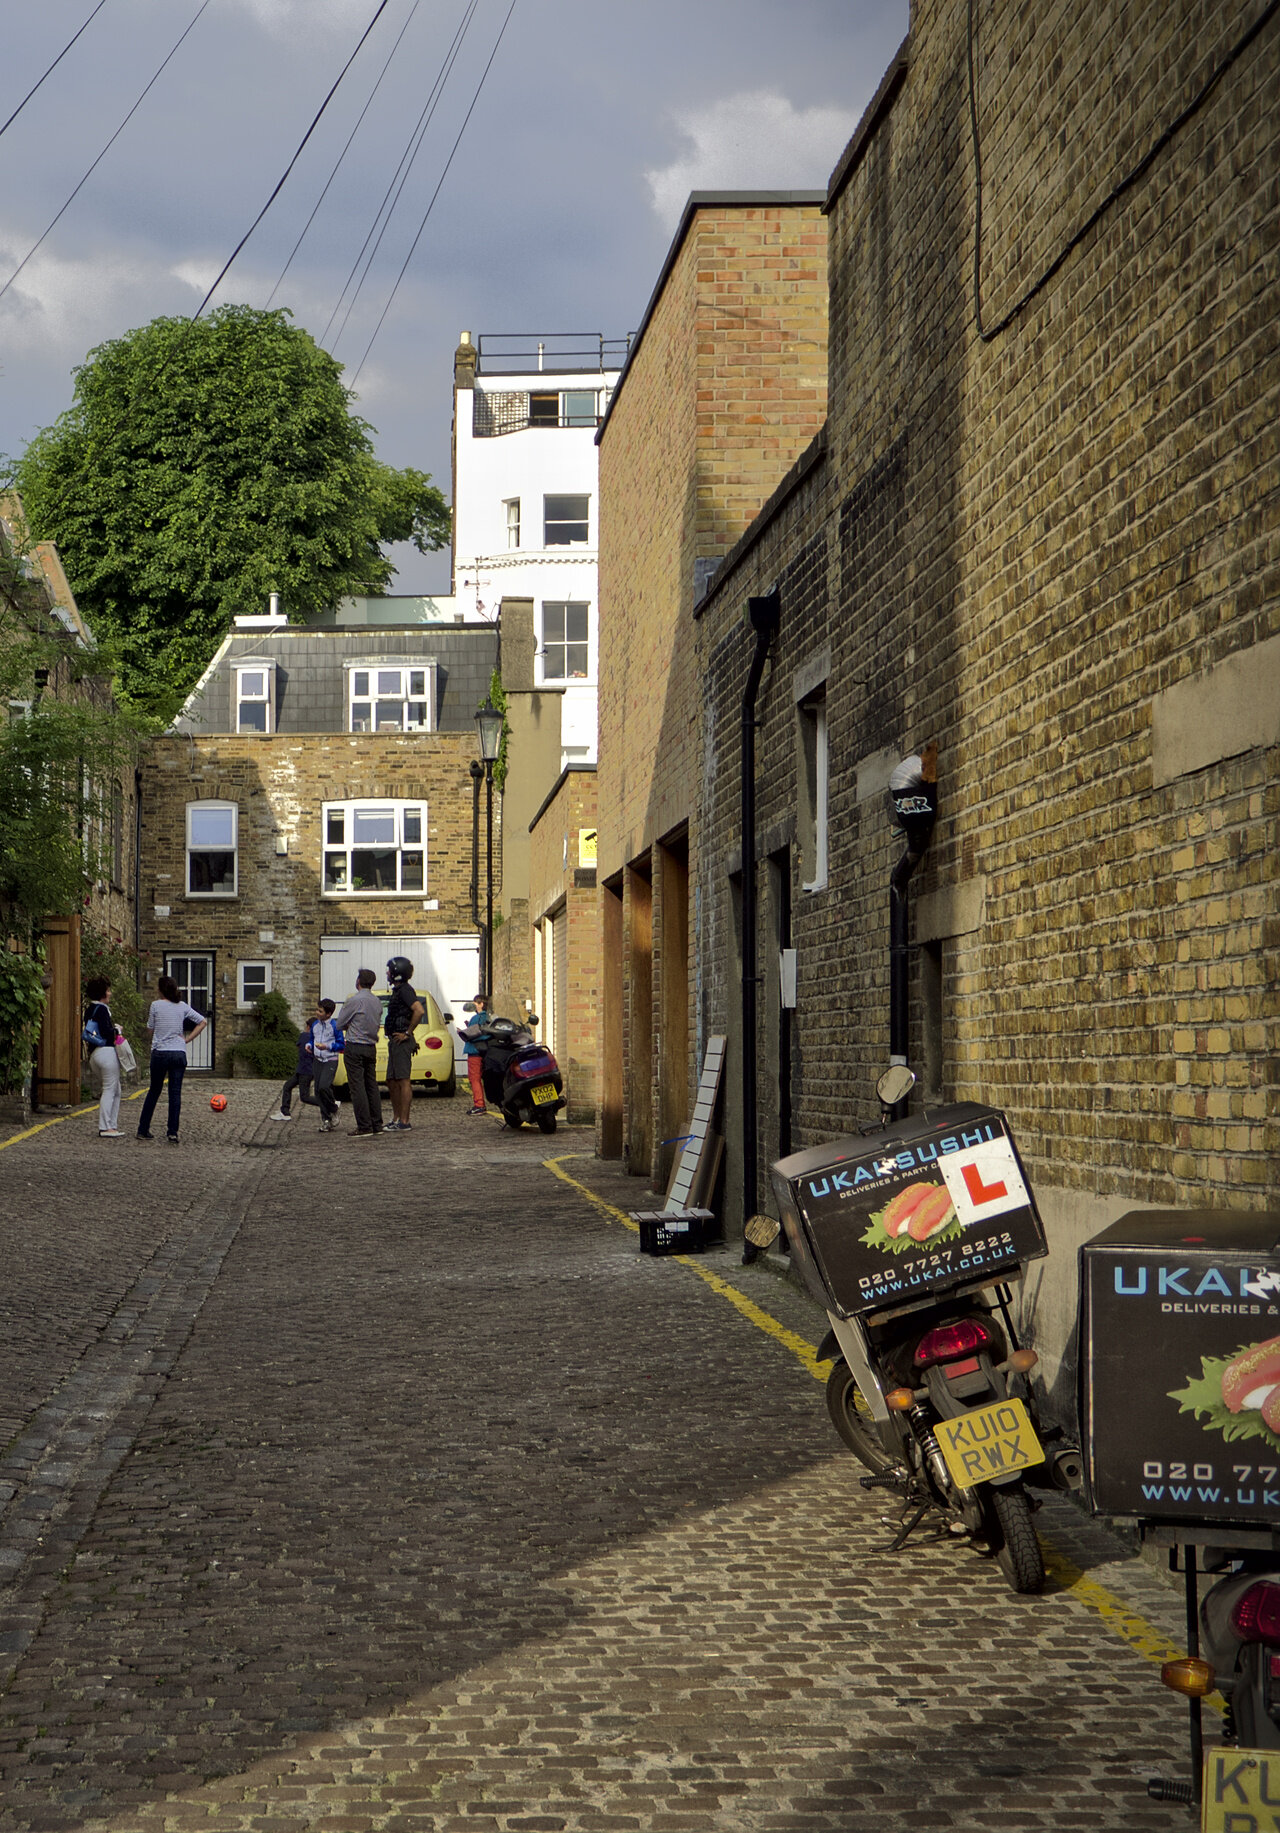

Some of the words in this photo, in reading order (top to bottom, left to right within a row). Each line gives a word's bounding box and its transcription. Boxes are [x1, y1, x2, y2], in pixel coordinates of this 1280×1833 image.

[808, 1160, 882, 1198] UKAI
[895, 1125, 994, 1170] SUSHI
[839, 1177, 891, 1199] DELIVERIES
[893, 1174, 900, 1182] &
[902, 1165, 928, 1179] PARTY
[960, 1162, 1008, 1206] L
[858, 1269, 896, 1289] 020
[904, 1250, 952, 1273] 7727
[962, 1232, 1012, 1256] 8222
[861, 1244, 1016, 1300] WWW.UKAI.CO.UK
[1114, 1266, 1249, 1297] UKAI
[1161, 1302, 1261, 1315] DELIVERIES
[1267, 1305, 1280, 1315] &
[946, 1407, 1020, 1451] KU10
[961, 1435, 1029, 1477] RWX
[1143, 1461, 1213, 1480] 020
[1232, 1465, 1278, 1483] 77
[1141, 1485, 1280, 1505] WWW.UK
[1215, 1757, 1280, 1807] KU
